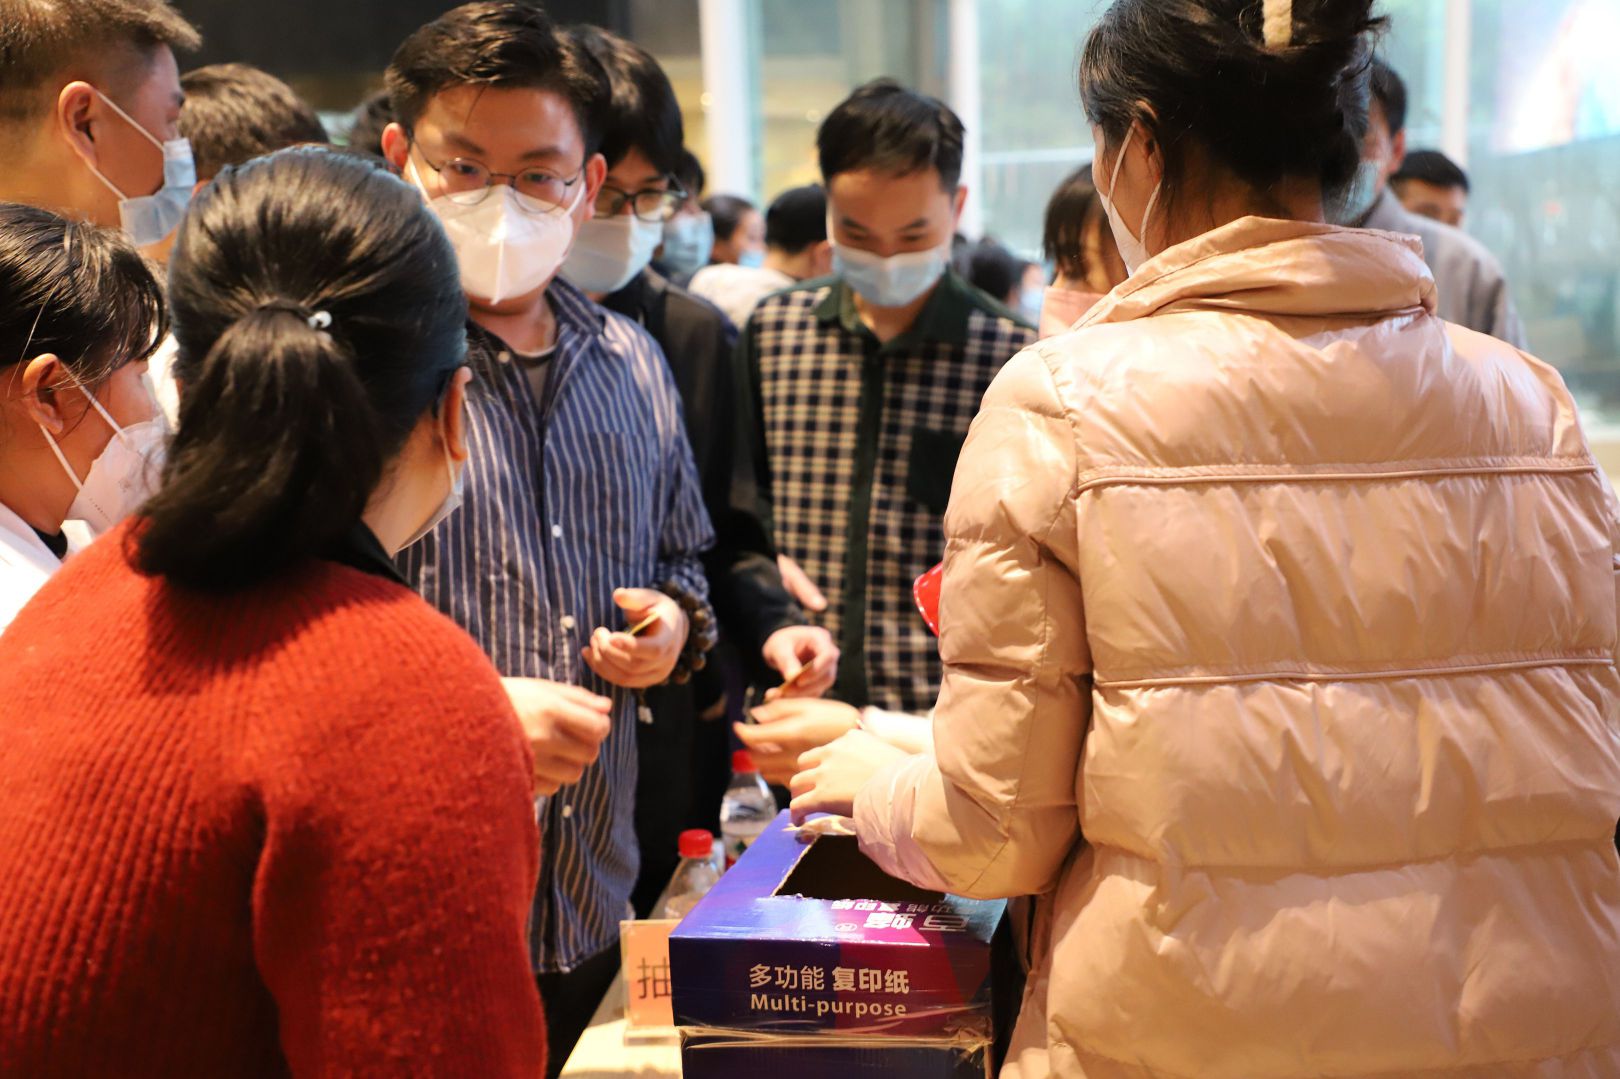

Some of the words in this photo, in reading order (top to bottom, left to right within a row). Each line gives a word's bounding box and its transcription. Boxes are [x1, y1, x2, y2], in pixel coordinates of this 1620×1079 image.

[637, 956, 671, 999] 抽
[749, 963, 825, 991] 多功能
[832, 966, 909, 994] 复印纸
[751, 994, 907, 1018] Multi-purpose
